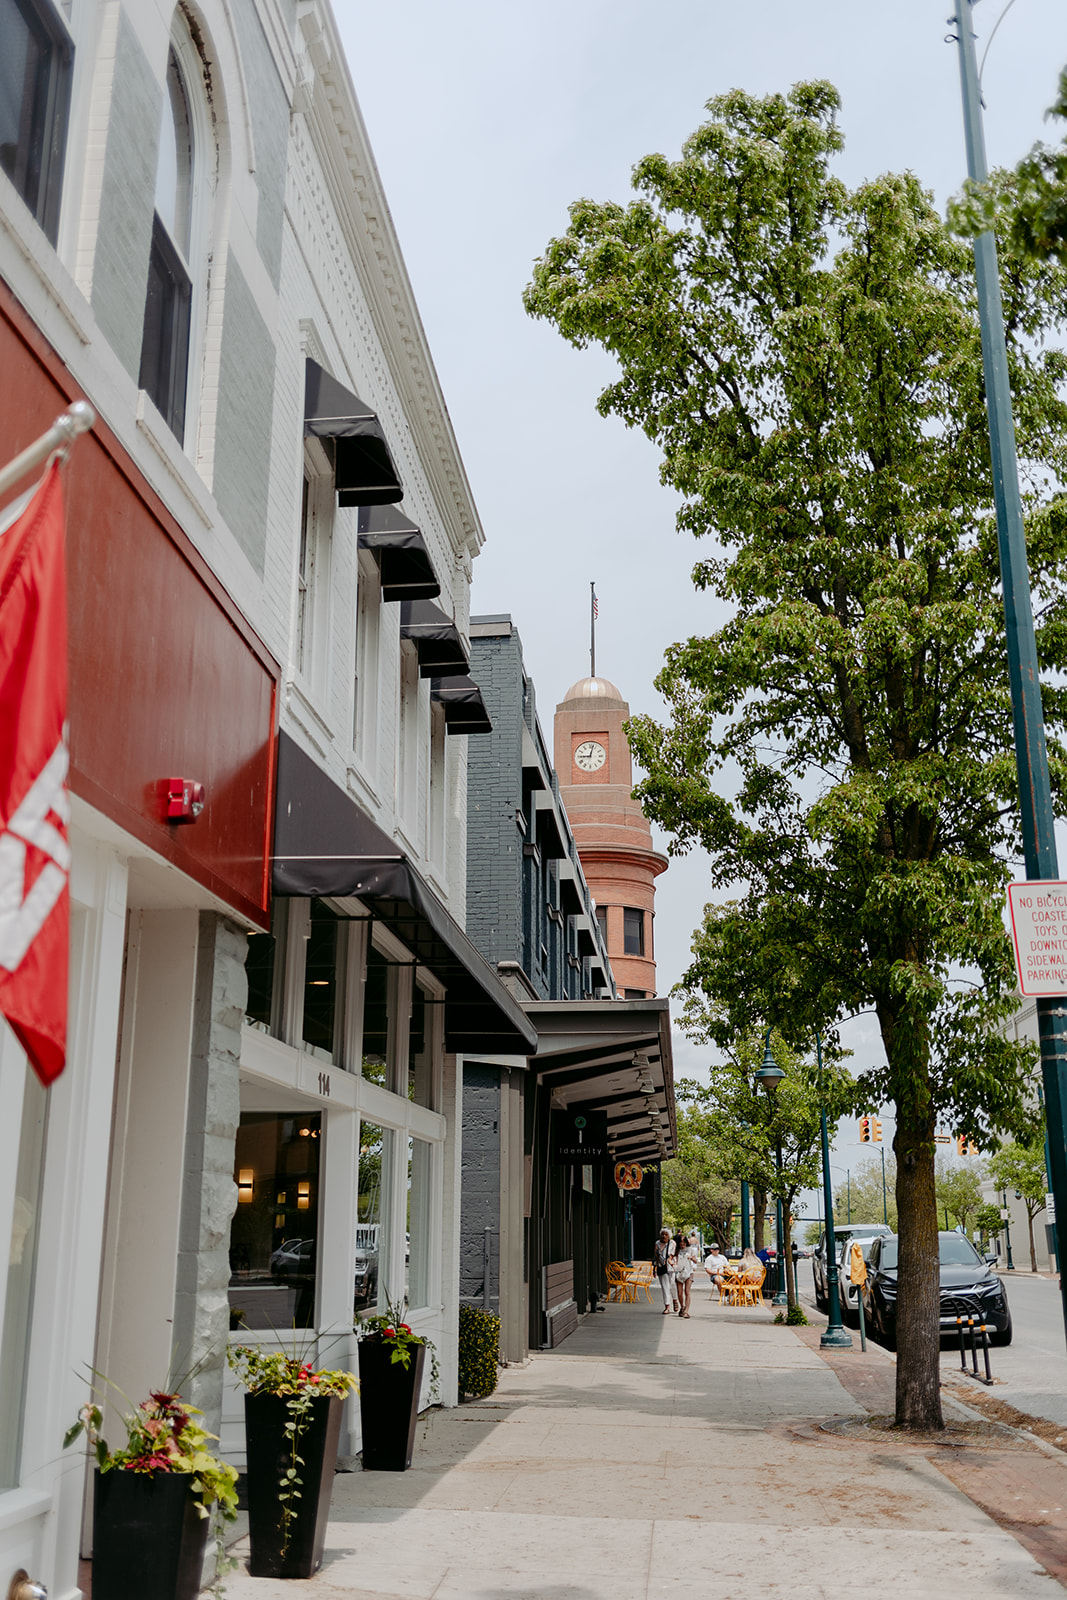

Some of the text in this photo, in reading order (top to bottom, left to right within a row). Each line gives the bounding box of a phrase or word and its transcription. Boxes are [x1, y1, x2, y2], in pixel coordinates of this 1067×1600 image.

[1019, 897, 1033, 908] NO
[1032, 911, 1067, 922] COASTE
[1034, 925, 1058, 936] TOYS
[1027, 954, 1067, 966] SIDEWAL
[1028, 969, 1067, 981] PARKING
[318, 1072, 330, 1096] 114
